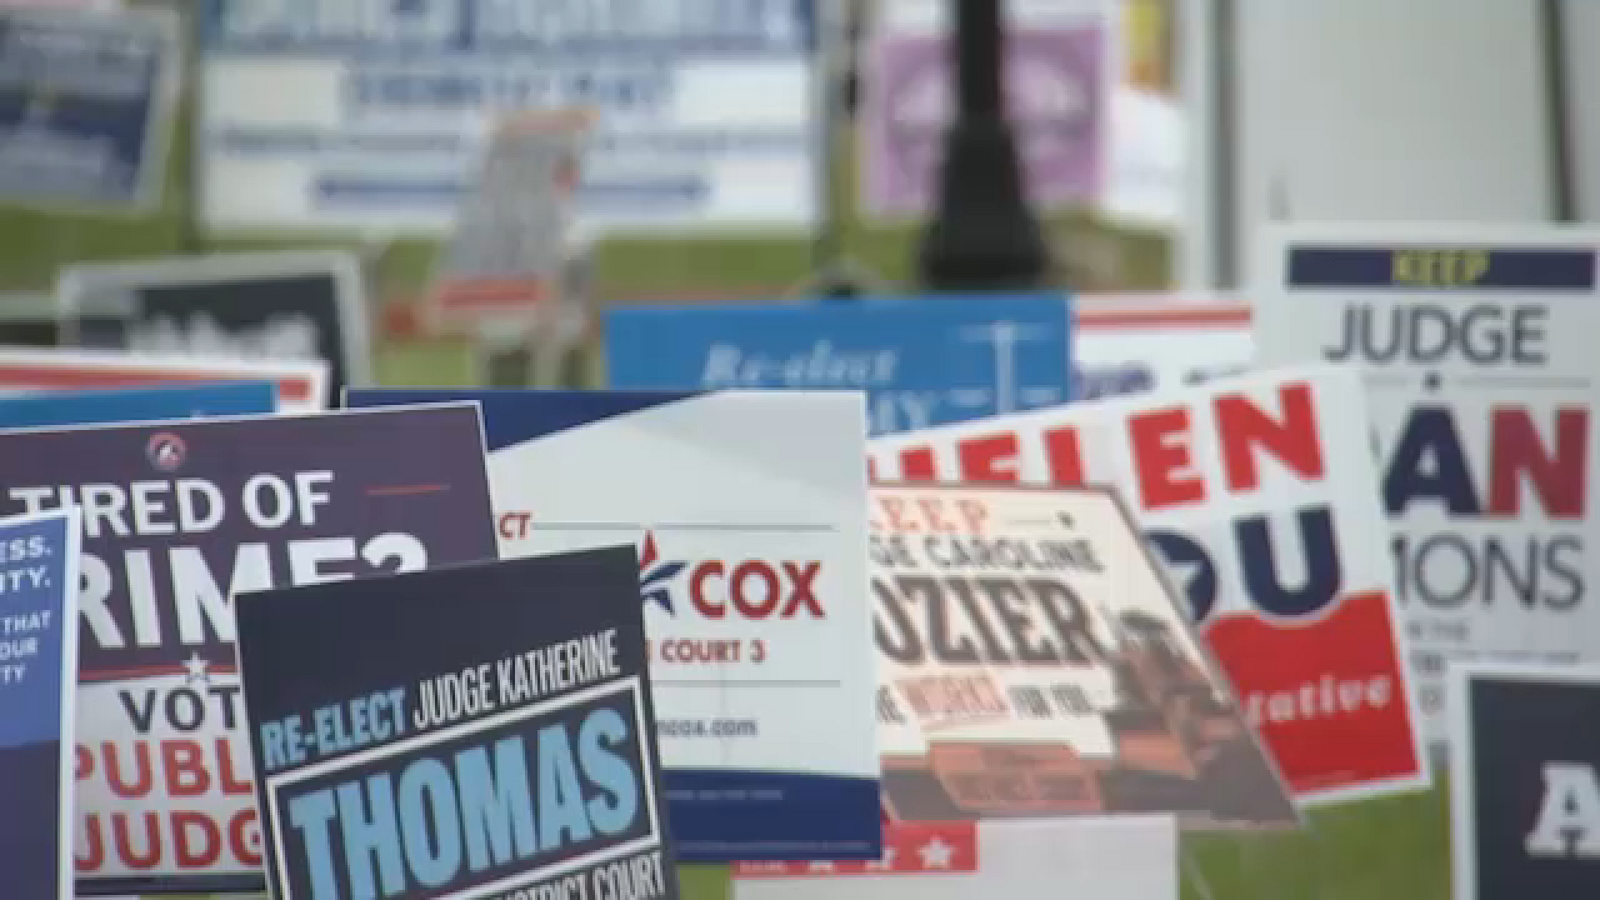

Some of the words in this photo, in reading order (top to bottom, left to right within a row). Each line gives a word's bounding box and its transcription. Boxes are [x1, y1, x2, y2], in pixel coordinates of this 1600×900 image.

[1392, 249, 1490, 287] KEEP
[1324, 304, 1548, 365] JUDGE
[1370, 405, 1591, 522] AN
[242, 468, 335, 528] OF
[868, 497, 987, 532] EEP
[922, 534, 1106, 575] CAROLINE
[689, 559, 827, 620] COX
[661, 639, 741, 663] COURT
[749, 639, 767, 664] 3
[261, 687, 407, 770] RE-ELECT
[412, 663, 496, 731] JUDGE
[497, 628, 621, 706] KATHERINE
[288, 707, 639, 900] THOMAS
[592, 850, 666, 897] COURT
